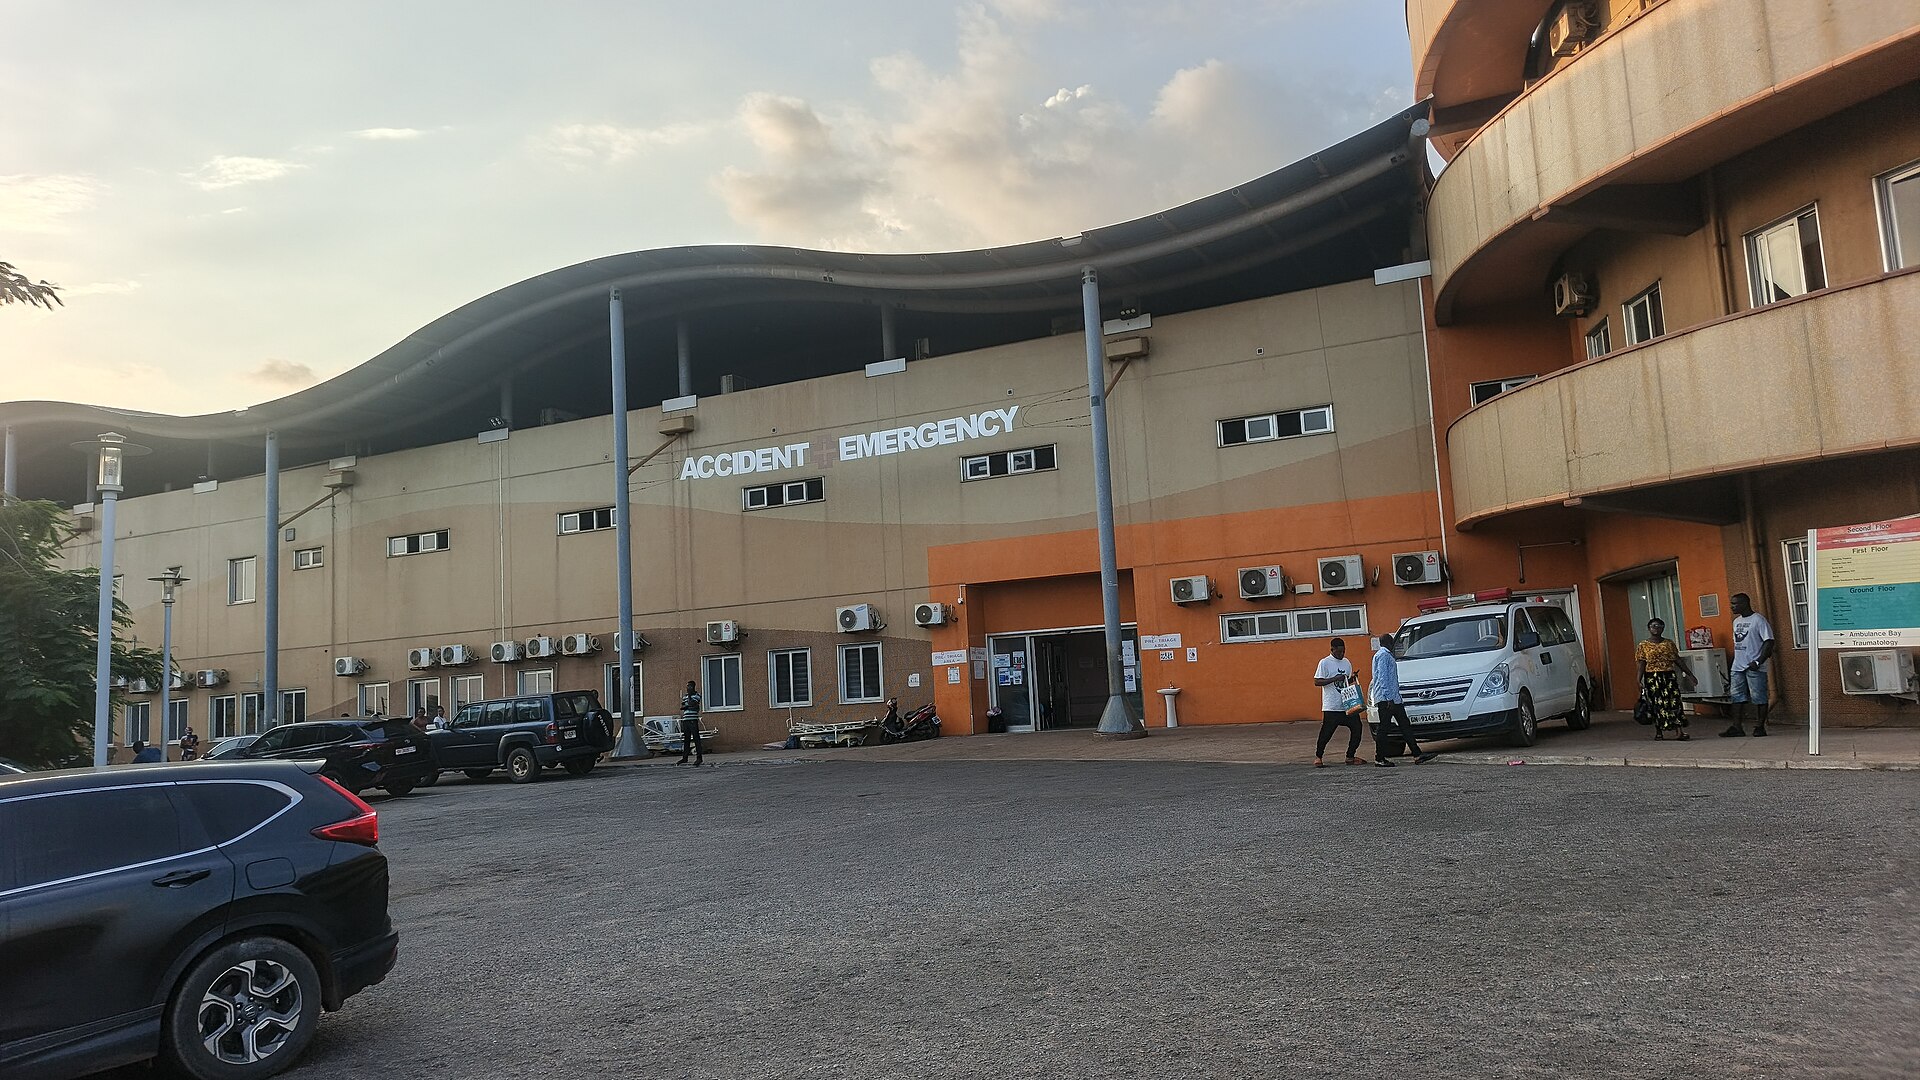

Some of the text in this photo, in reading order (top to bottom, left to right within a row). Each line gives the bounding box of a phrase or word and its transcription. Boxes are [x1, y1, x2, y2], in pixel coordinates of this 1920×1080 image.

[680, 405, 1019, 481] ACCIDENT EMERGENCY
[1847, 525, 1871, 533] Second
